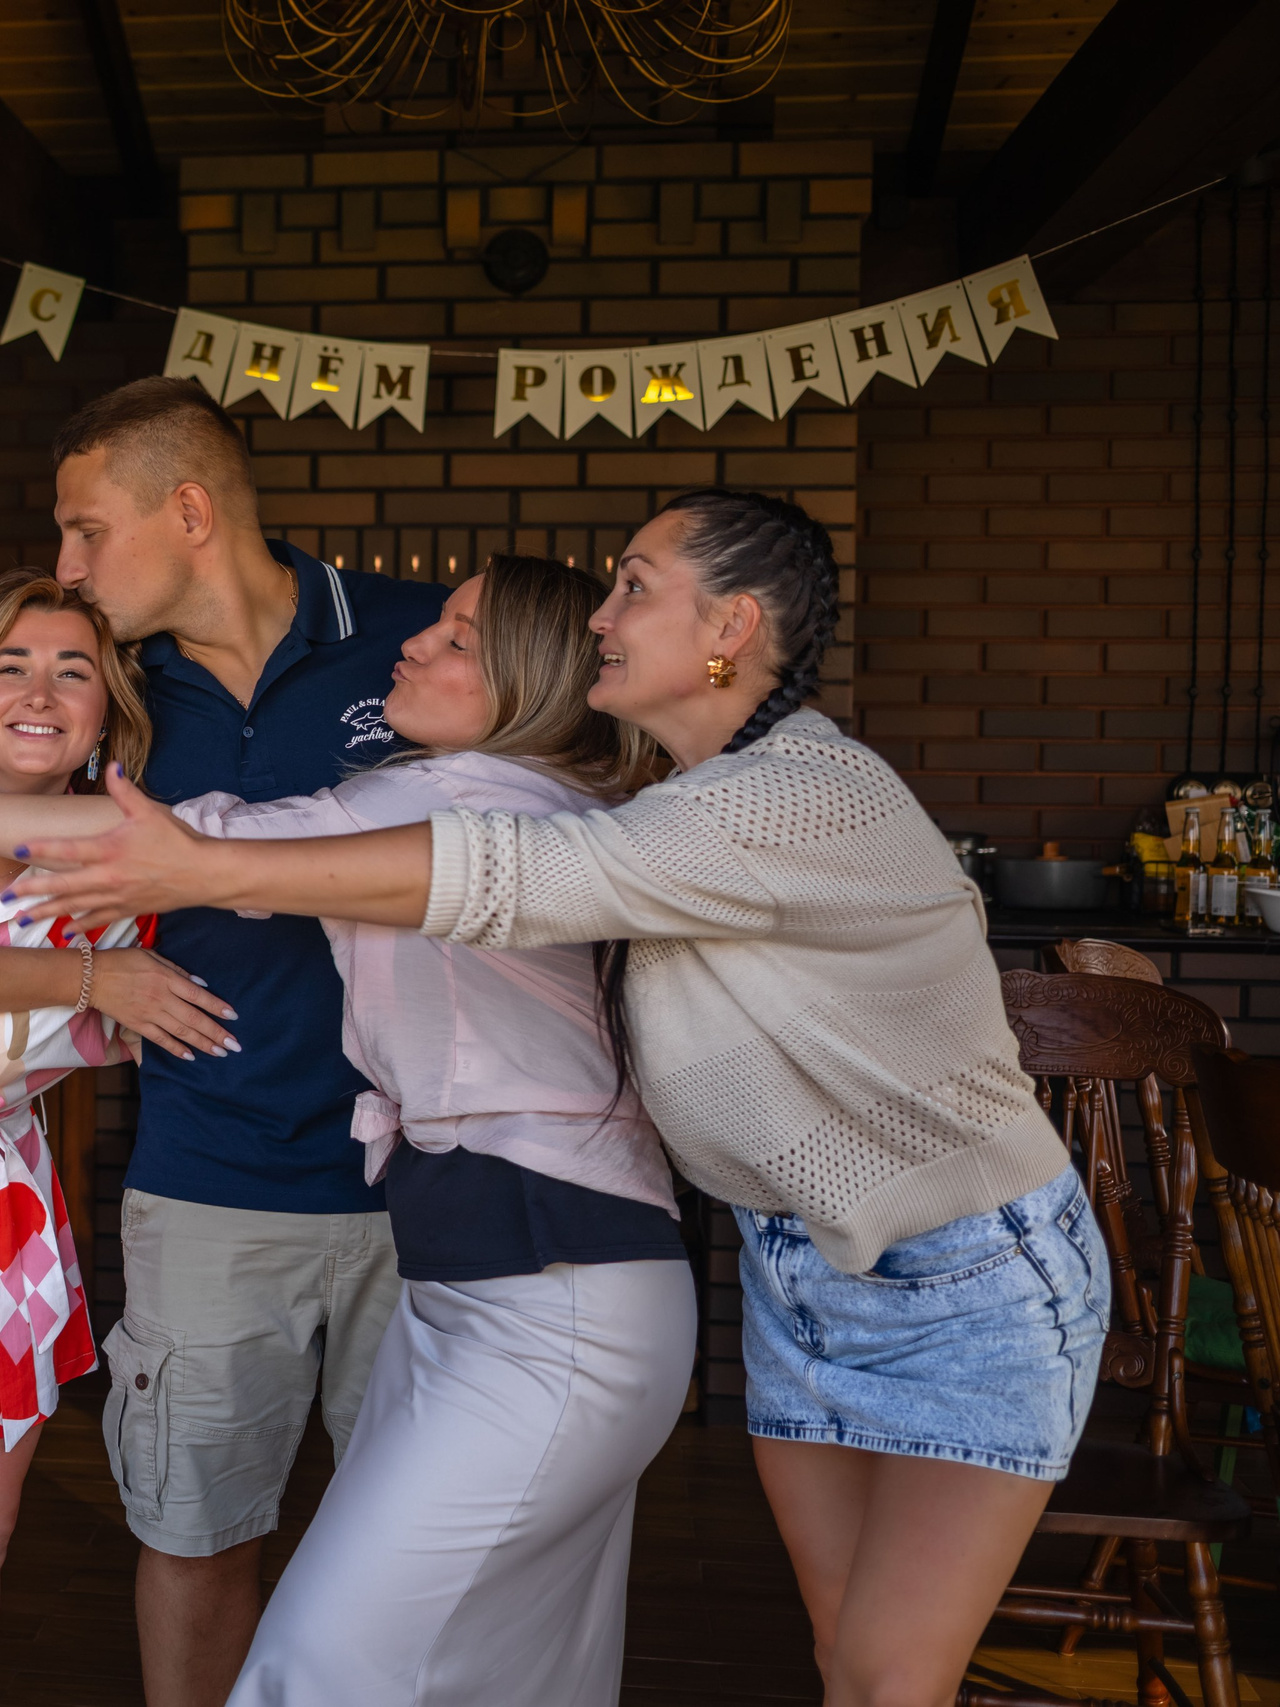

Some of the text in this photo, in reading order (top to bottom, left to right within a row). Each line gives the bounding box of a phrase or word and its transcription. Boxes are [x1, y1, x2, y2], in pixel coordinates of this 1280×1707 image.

[28, 279, 1031, 404] С ДНЁМ РОЖДЕНИЯ
[339, 698, 386, 723] PAUL & SHA
[344, 726, 395, 749] yachting
